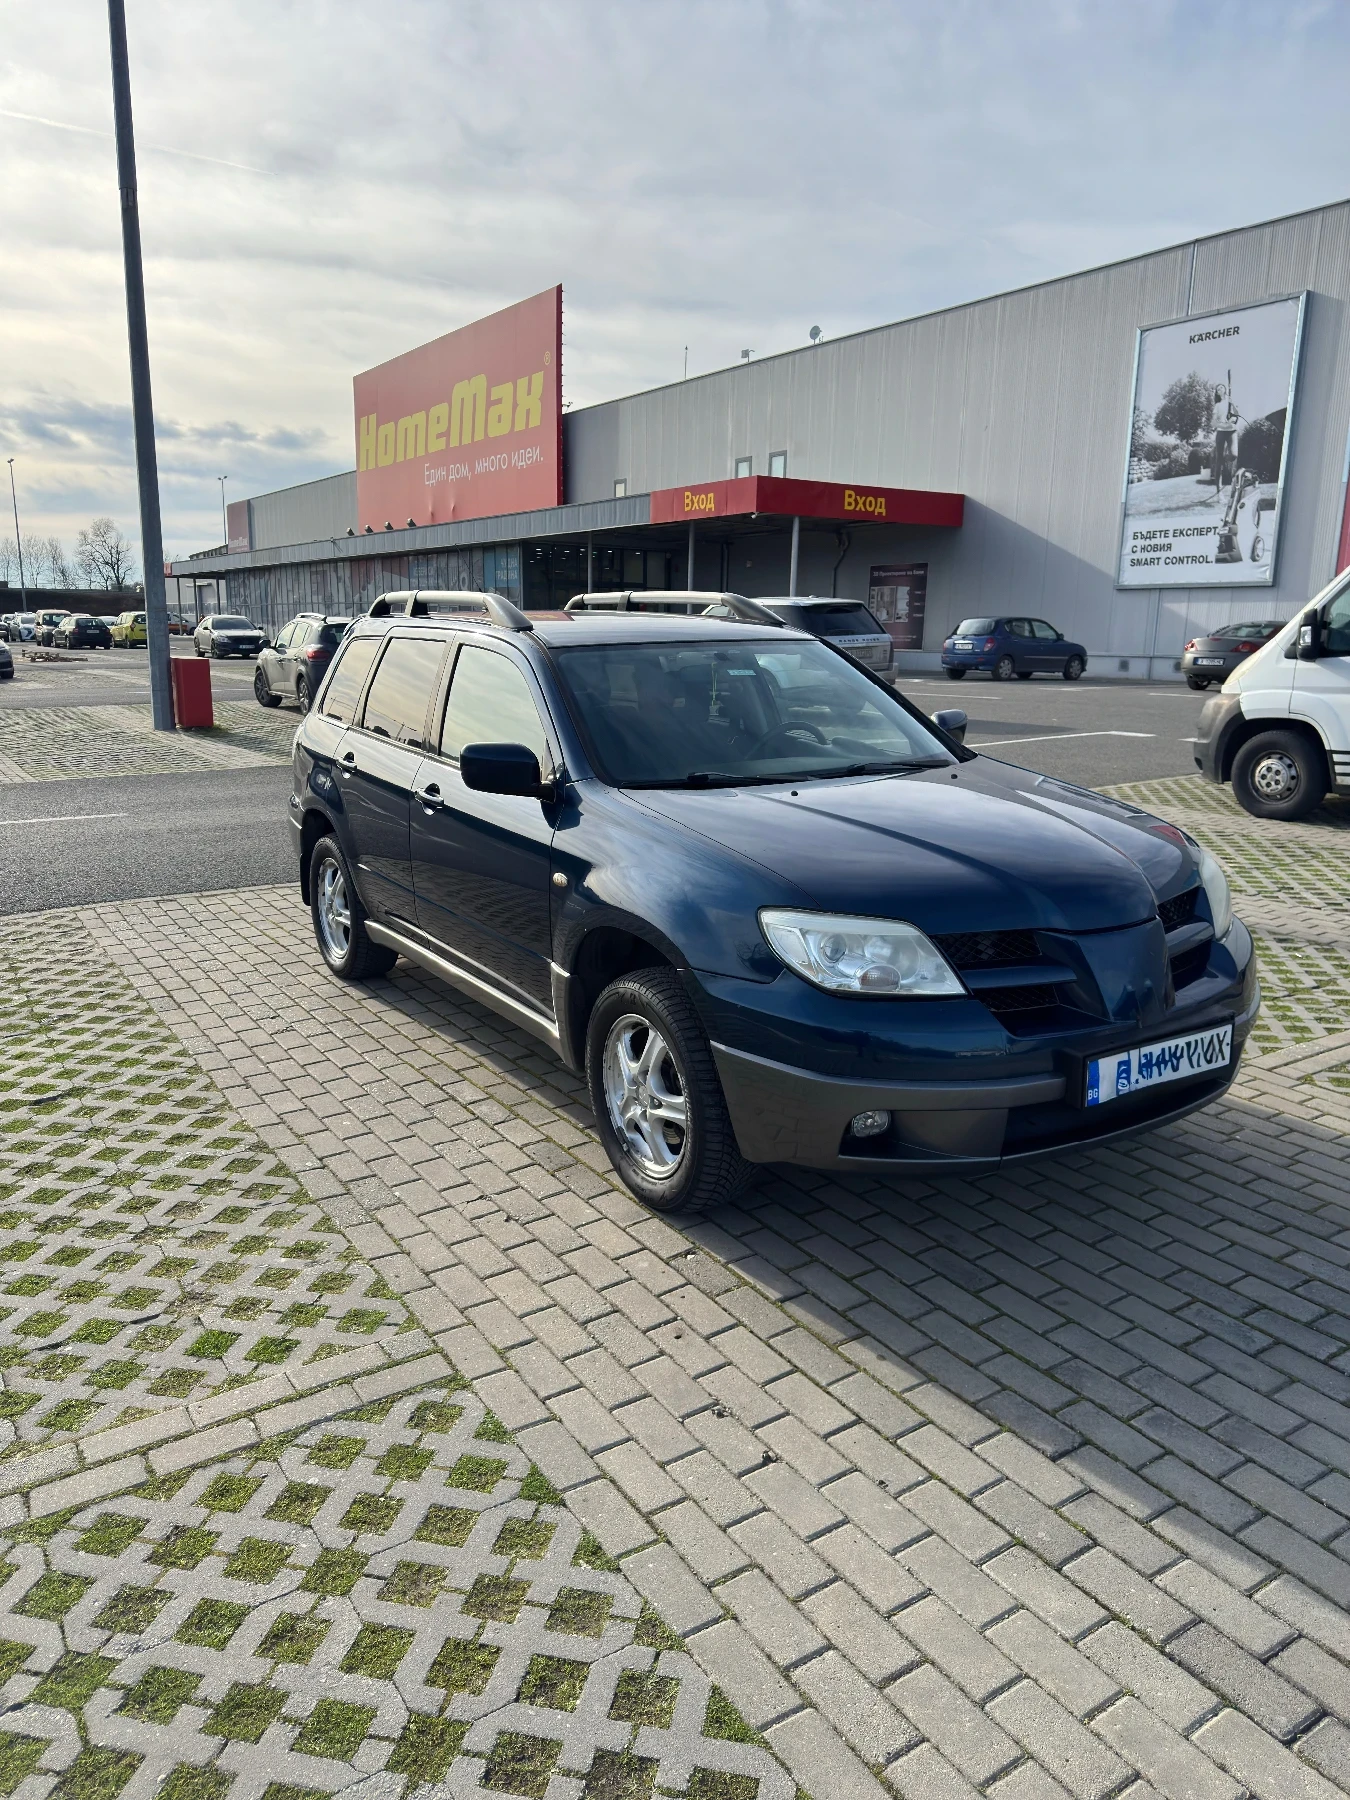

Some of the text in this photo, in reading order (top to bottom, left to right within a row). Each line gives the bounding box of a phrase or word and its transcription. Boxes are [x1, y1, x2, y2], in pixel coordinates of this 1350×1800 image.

[1189, 326, 1240, 344] KÄRCHER
[359, 371, 544, 472] HomeMax
[424, 446, 544, 487] Един дом, много идеи.
[684, 491, 715, 512] Вход
[844, 490, 887, 516] Вход
[1132, 529, 1170, 541] БЪДЕТЕ
[1131, 543, 1172, 553] С НОВИЯ
[1130, 555, 1213, 567] SMART CONTROL.
[1088, 1089, 1099, 1100] BG
